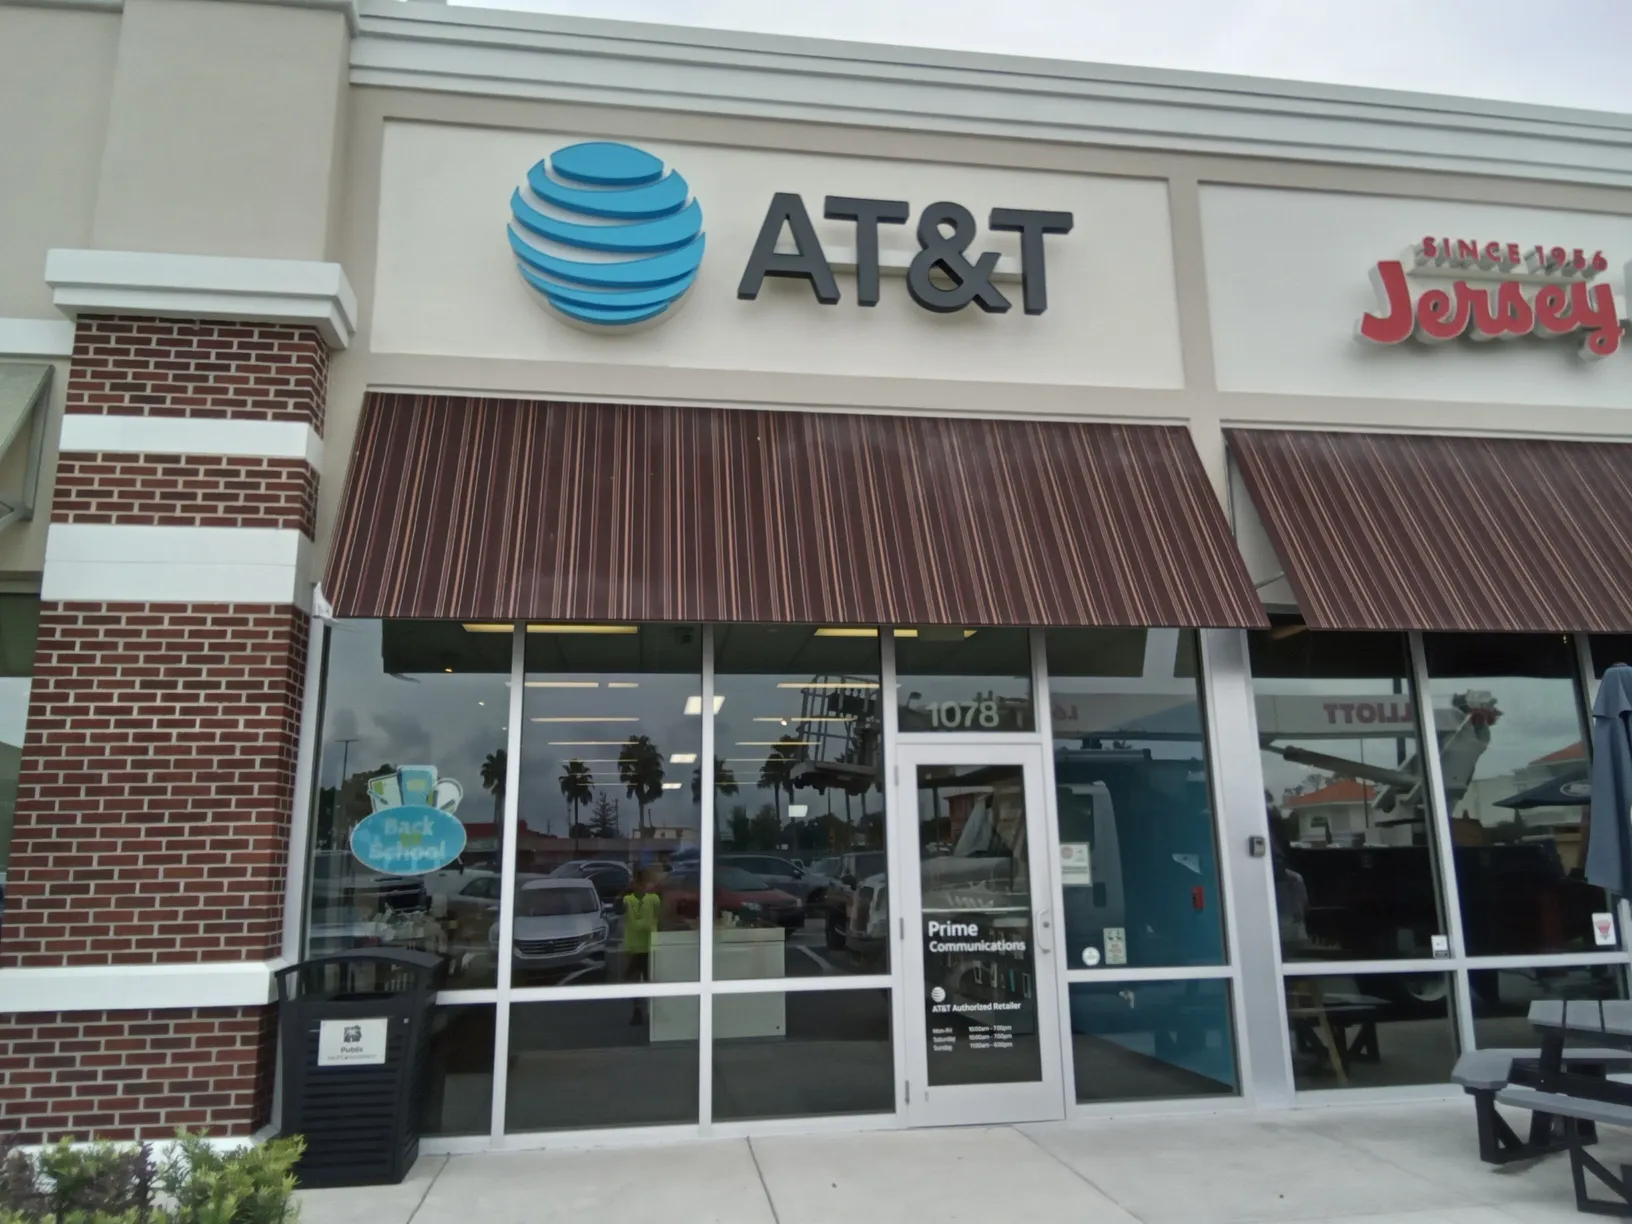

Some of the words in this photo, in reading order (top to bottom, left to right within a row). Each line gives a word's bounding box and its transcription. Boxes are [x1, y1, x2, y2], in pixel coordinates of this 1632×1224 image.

[737, 192, 1074, 316] AT&T
[1422, 236, 1521, 265] SINCE
[1534, 244, 1608, 272] 1956
[1360, 260, 1624, 355] Jersey
[925, 701, 1000, 728] 1078
[384, 815, 433, 836] Back
[368, 838, 446, 859] School
[928, 920, 979, 937] Prime
[929, 940, 1026, 952] Communications
[932, 1004, 951, 1013] AT&T
[952, 1003, 992, 1011] Authorized
[993, 1001, 1021, 1010] Retailer
[341, 1046, 364, 1054] Publix
